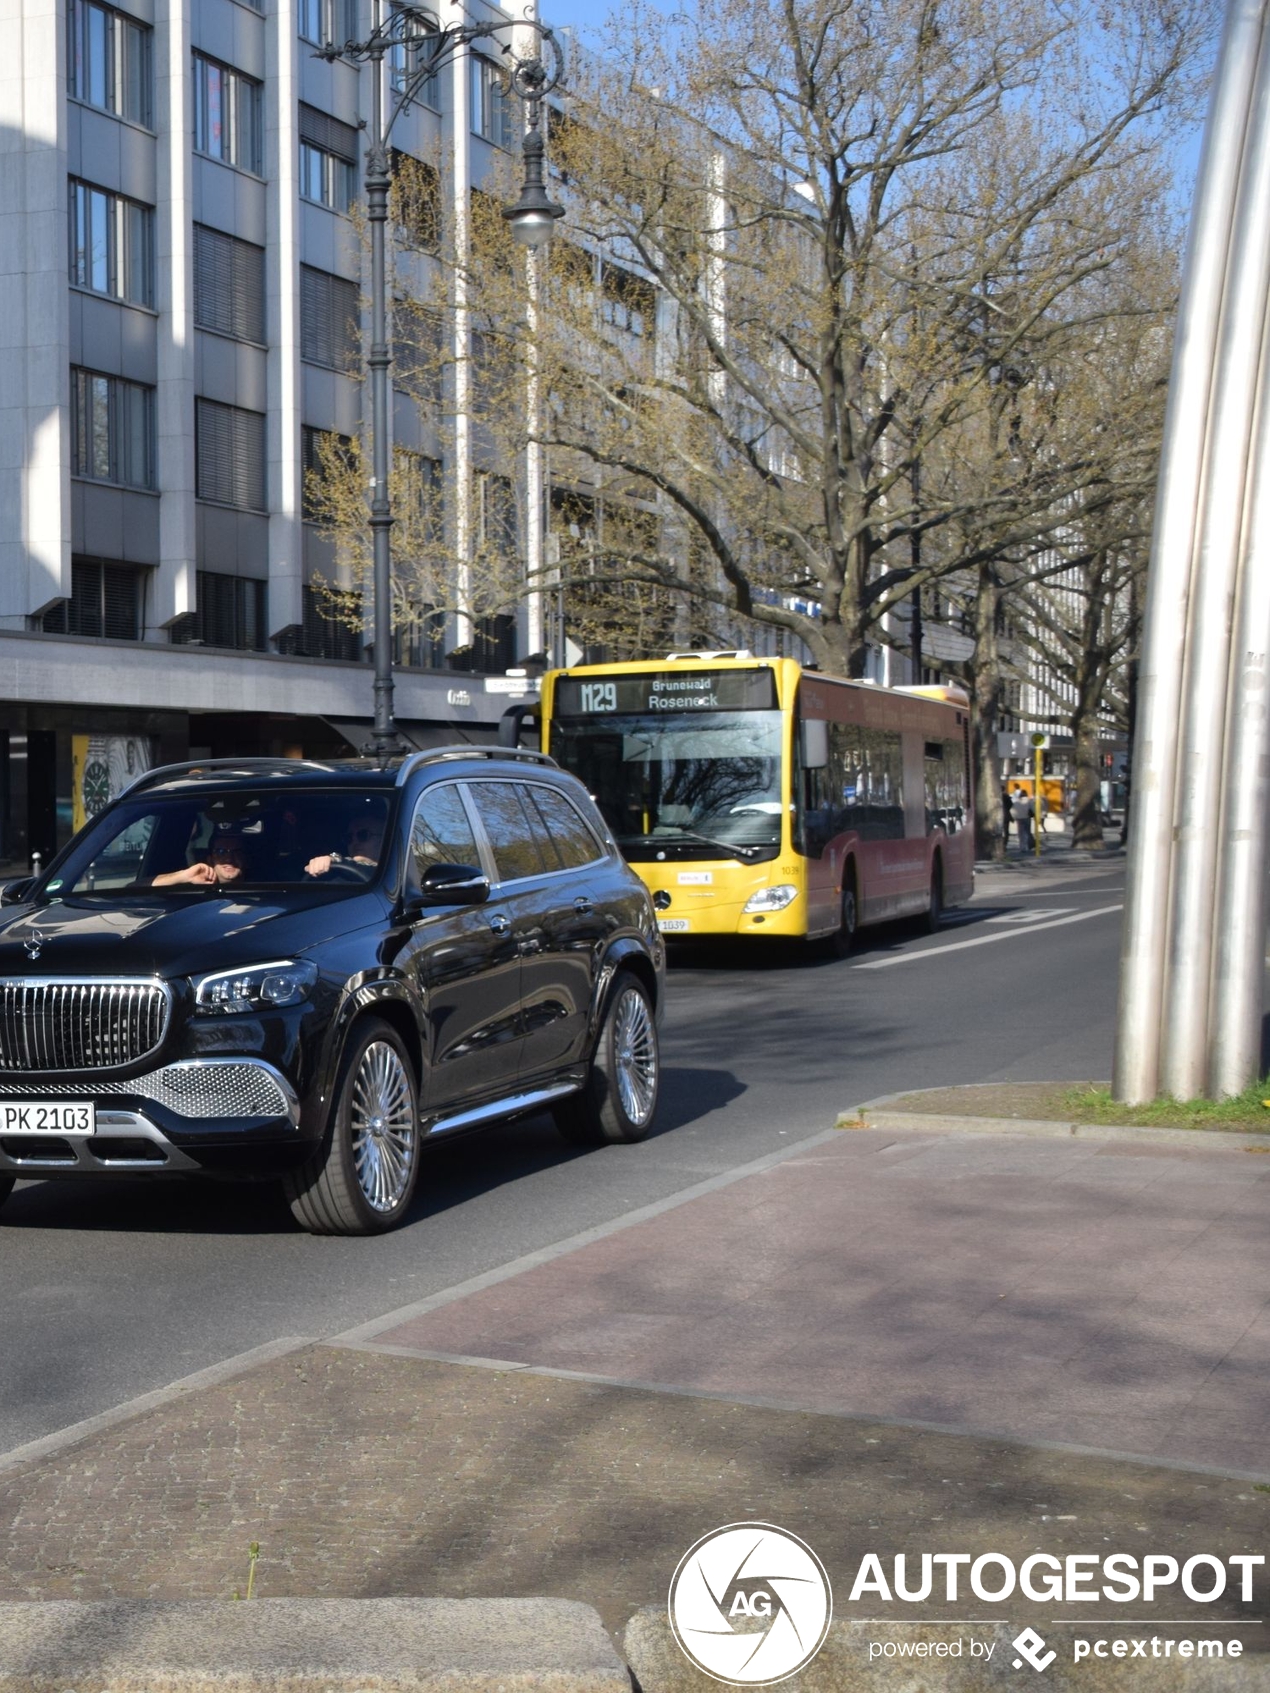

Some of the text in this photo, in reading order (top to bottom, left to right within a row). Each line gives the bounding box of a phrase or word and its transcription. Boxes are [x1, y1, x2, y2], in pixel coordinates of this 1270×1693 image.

[652, 679, 711, 692] Grunewald
[581, 683, 617, 712] M29
[649, 693, 718, 709] Roseneck
[782, 866, 800, 875] 1039
[663, 920, 685, 930] 1039
[5, 1108, 31, 1129] PK
[36, 1108, 89, 1130] 2103
